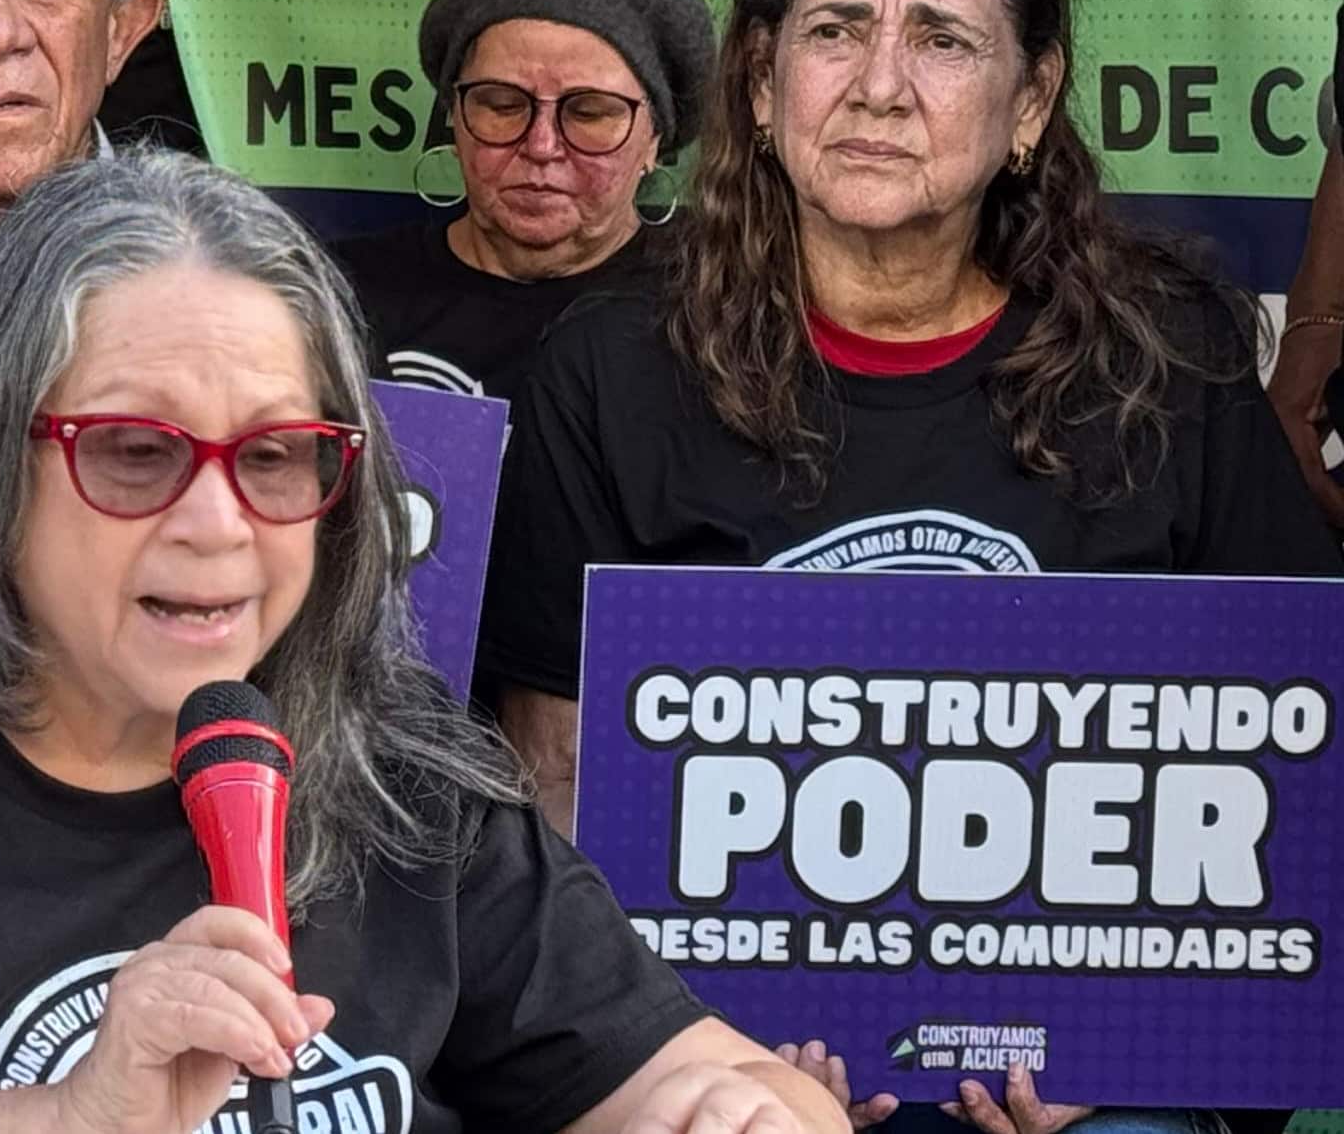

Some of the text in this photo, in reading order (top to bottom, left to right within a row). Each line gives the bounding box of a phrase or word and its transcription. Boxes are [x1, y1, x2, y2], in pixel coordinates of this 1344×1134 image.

[1101, 65, 1220, 154] DE
[911, 526, 962, 553] OTRO
[960, 537, 1025, 572] ACUER
[635, 674, 1327, 754] CONSTRUYENDO
[678, 755, 1269, 906] PODER
[809, 920, 912, 966] LAS
[930, 923, 1313, 973] COMUNIDADES
[0, 982, 110, 1091] CONSTRUYA
[917, 1024, 1047, 1048] CONSTRUYAMOS
[921, 1050, 956, 1069] OTRO
